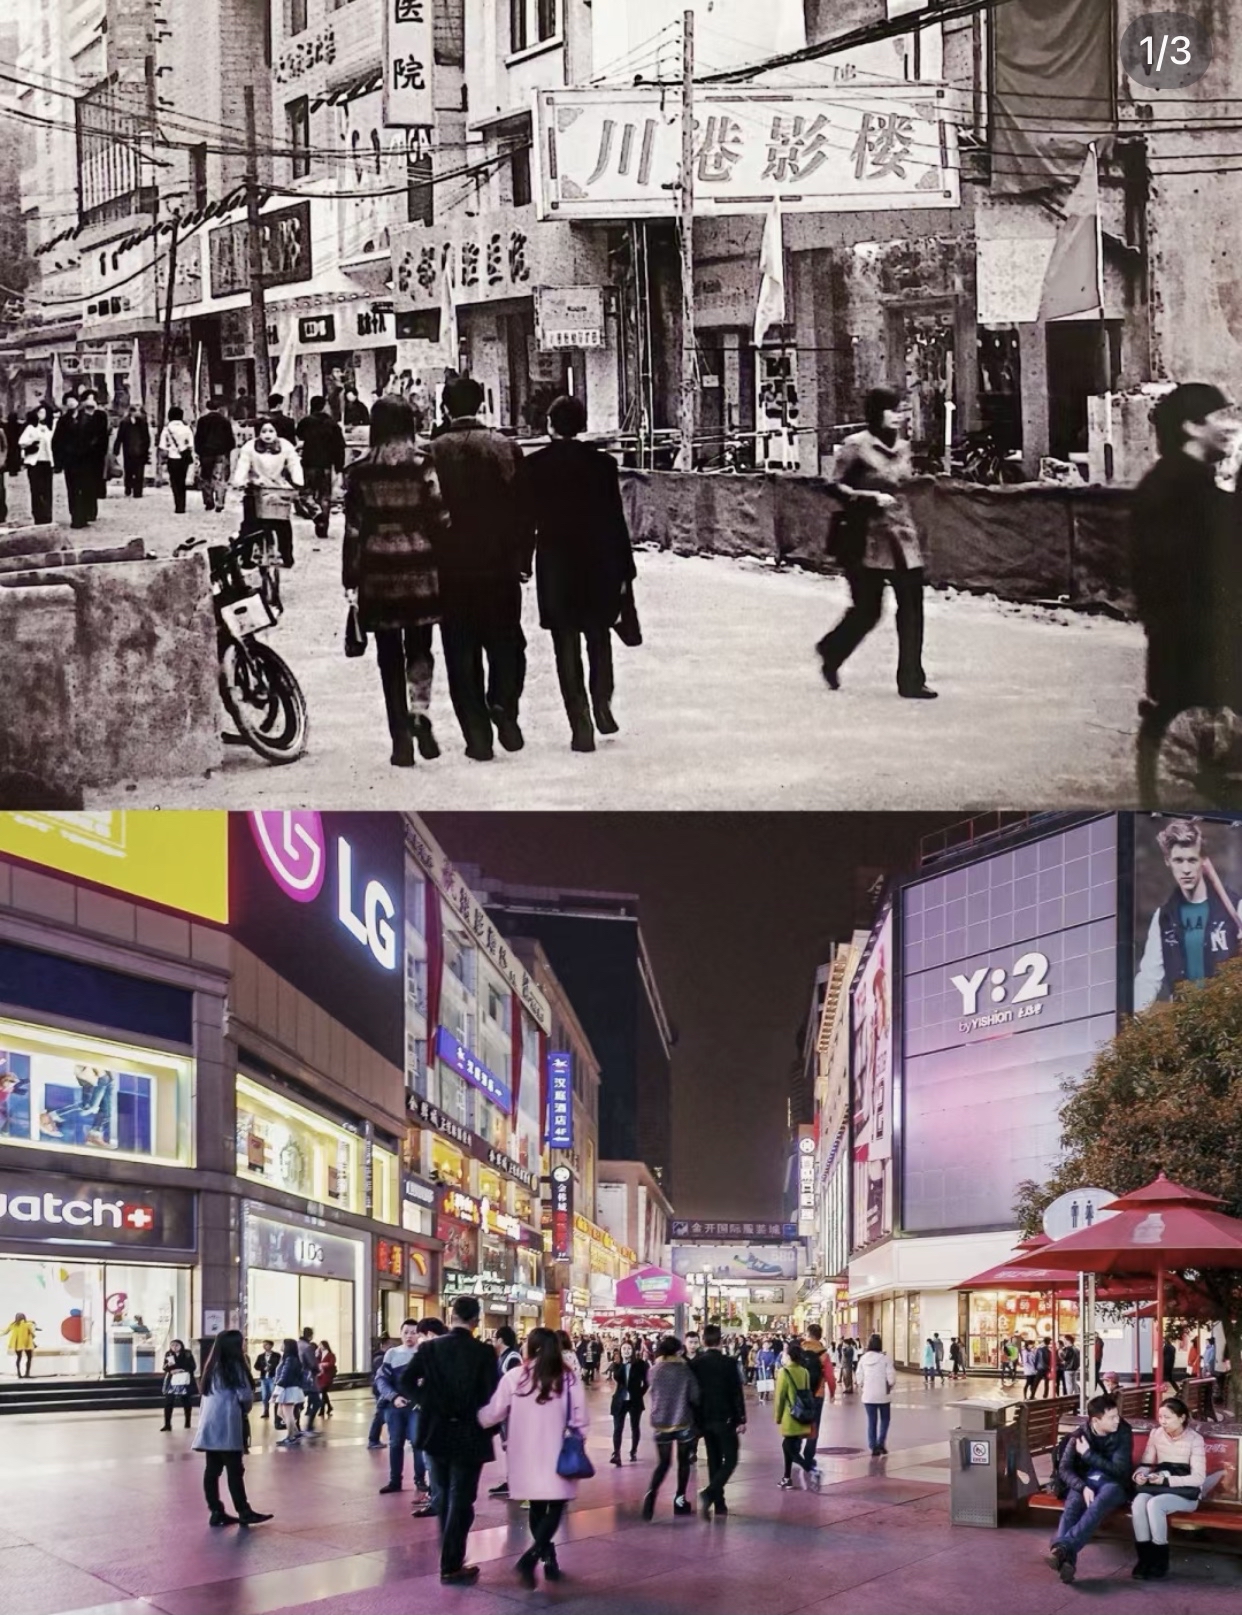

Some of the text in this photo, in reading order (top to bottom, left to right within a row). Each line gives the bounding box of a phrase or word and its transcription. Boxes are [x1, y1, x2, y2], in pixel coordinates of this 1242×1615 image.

[393, 0, 426, 90] 医院
[338, 837, 396, 970] LG
[949, 952, 1050, 1017] Y:2
